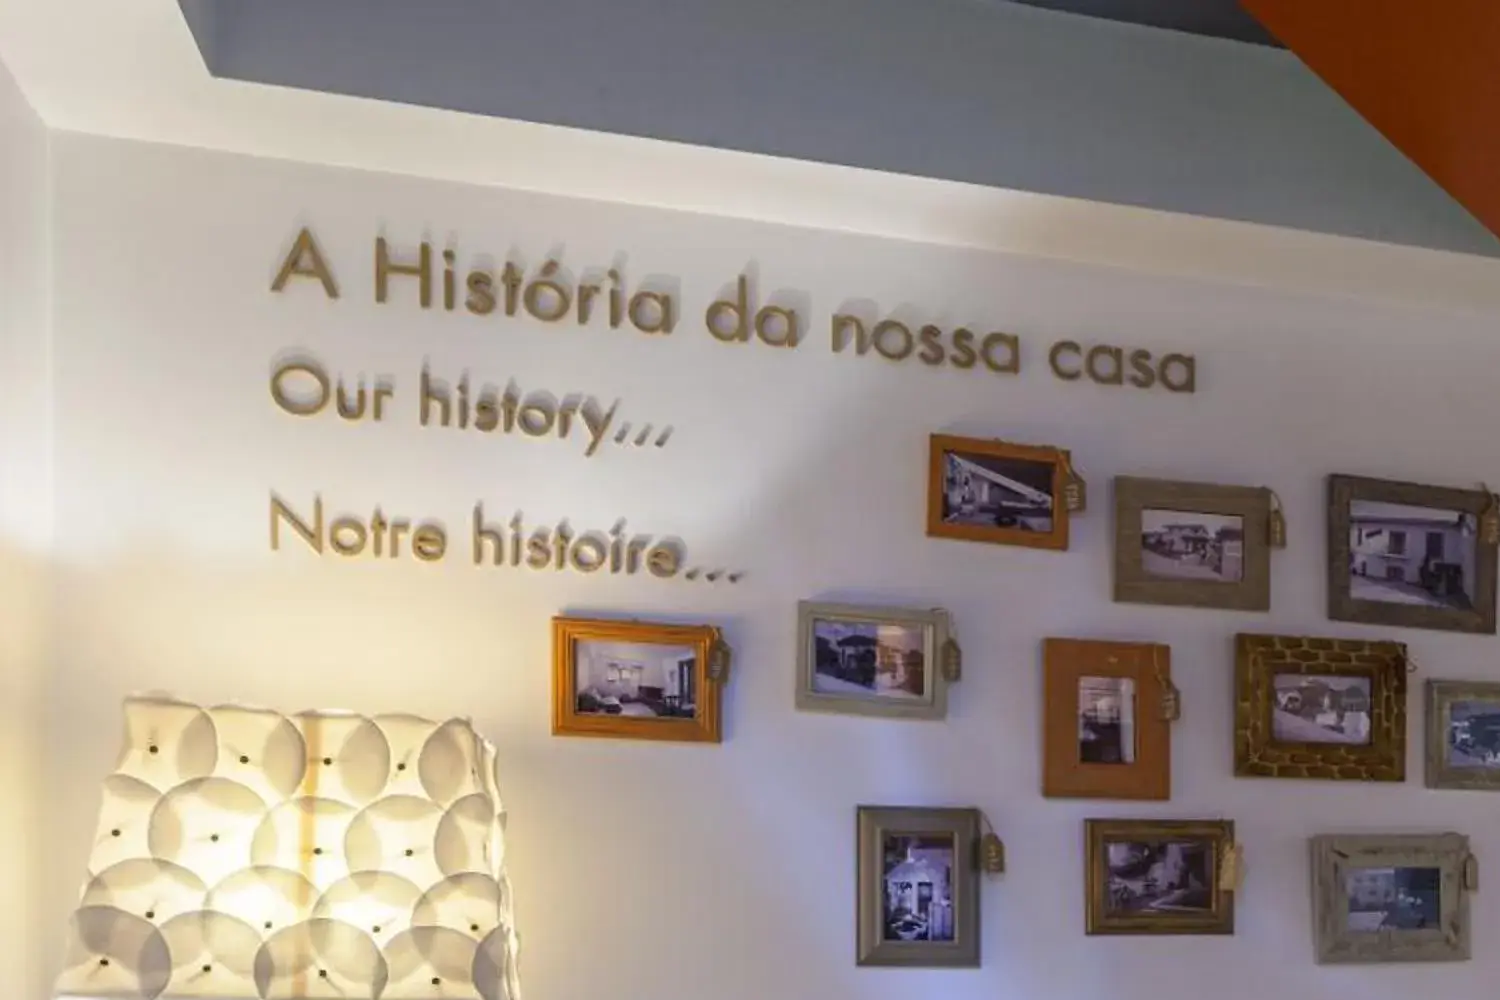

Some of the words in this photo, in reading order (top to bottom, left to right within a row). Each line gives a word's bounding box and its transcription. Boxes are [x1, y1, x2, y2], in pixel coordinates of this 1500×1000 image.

[270, 226, 340, 299] A
[375, 236, 675, 335] História
[704, 274, 799, 348] da
[831, 312, 1021, 374] nossa
[1048, 339, 1196, 393] casa
[270, 362, 394, 421] Our
[269, 492, 447, 561] Notre
